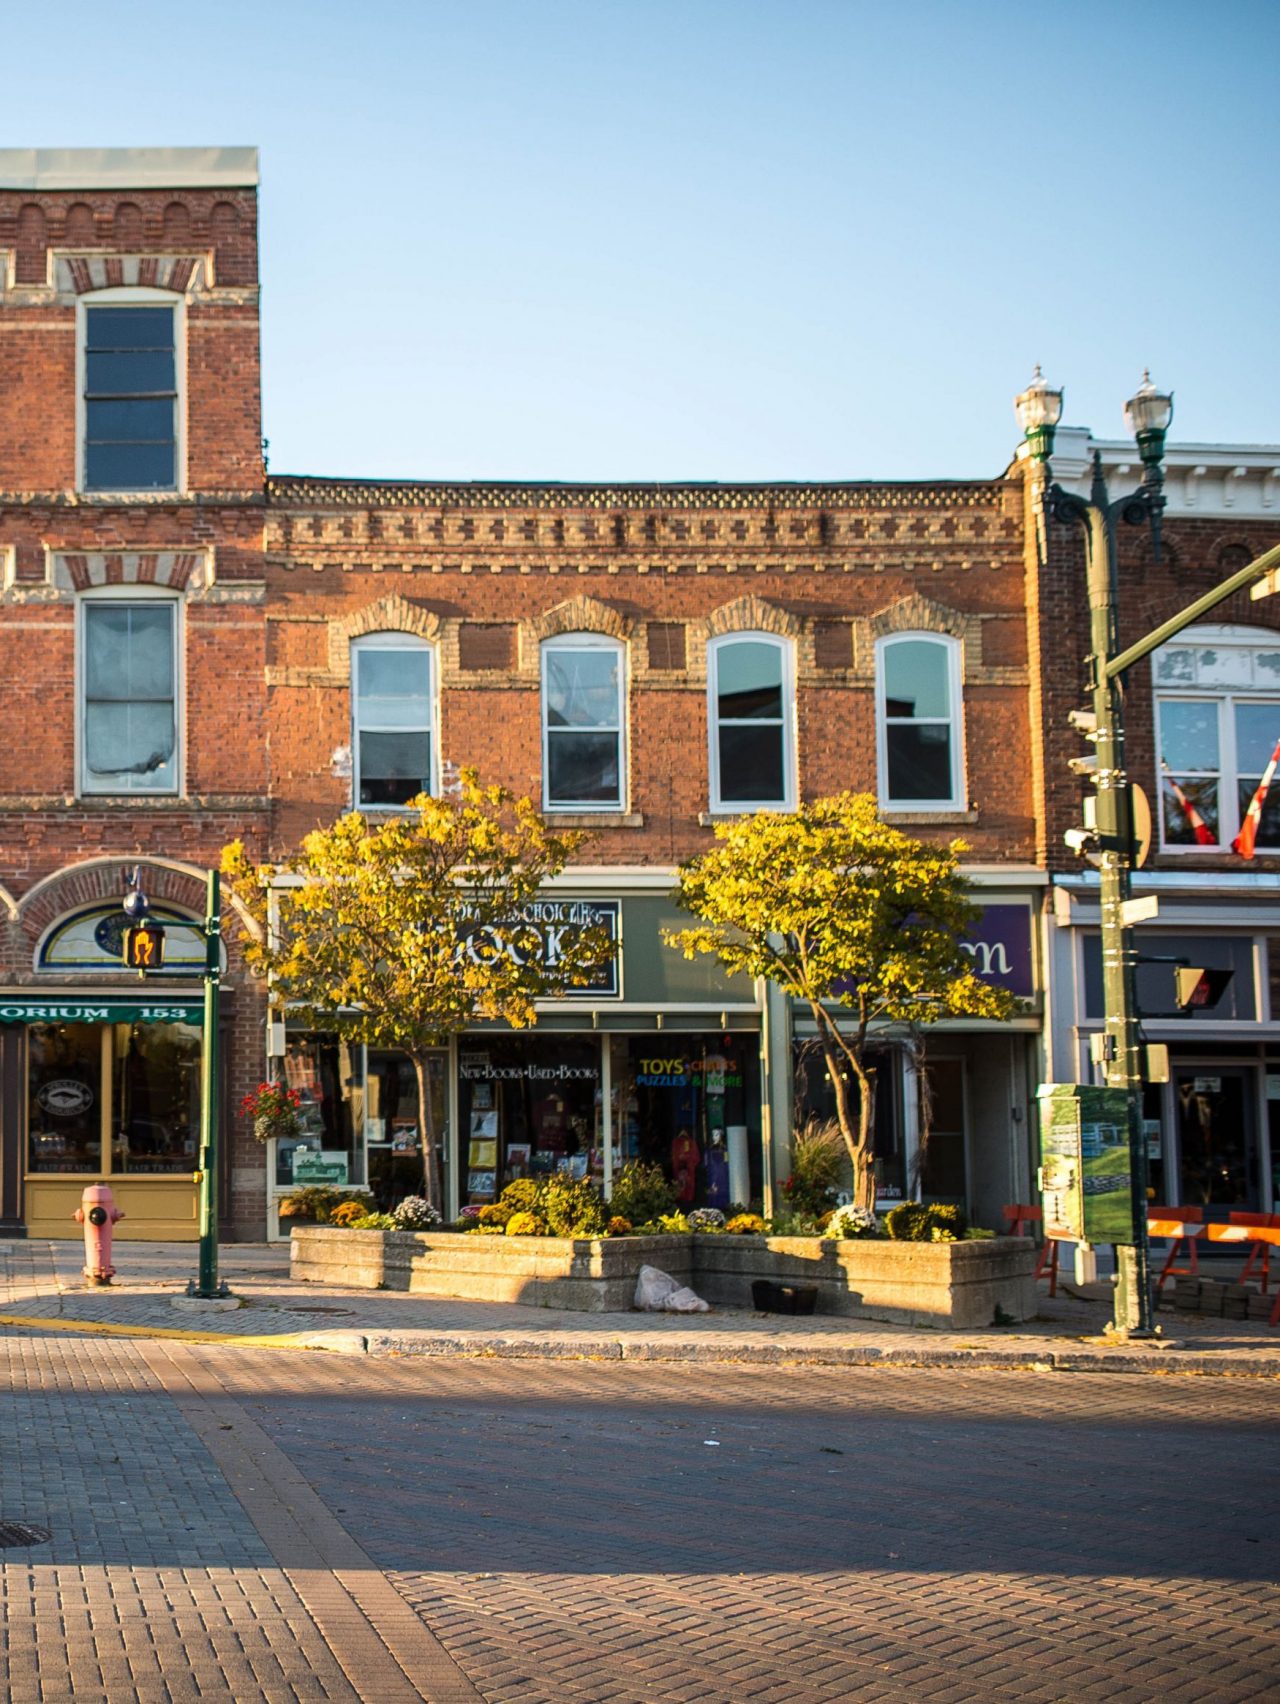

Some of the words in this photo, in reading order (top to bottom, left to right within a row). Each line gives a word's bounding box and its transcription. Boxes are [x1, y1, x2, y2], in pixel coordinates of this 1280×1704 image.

[434, 924, 600, 967] OOK
[139, 1008, 187, 1018] 153
[640, 1059, 684, 1075] TOYS
[636, 1075, 687, 1087] PUZZLES
